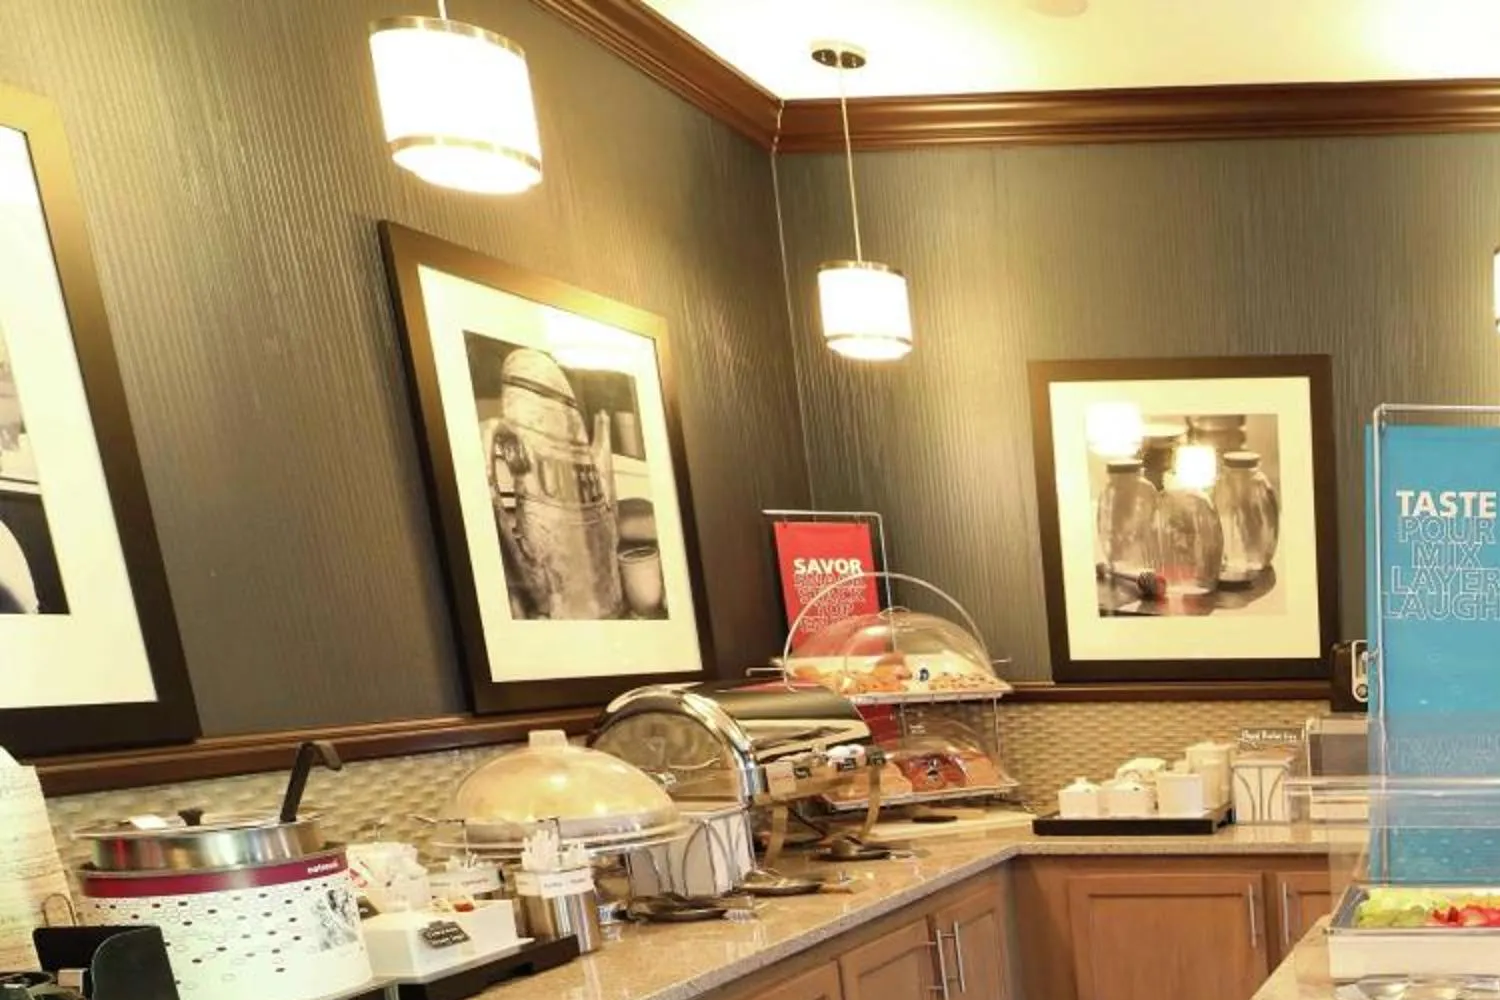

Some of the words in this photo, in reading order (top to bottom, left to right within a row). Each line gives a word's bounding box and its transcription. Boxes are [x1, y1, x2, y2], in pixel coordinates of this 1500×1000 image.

[1396, 490, 1497, 518] TASTE
[1399, 515, 1497, 544] POUR
[793, 558, 863, 576] SAVOR
[1411, 540, 1481, 569] MIX
